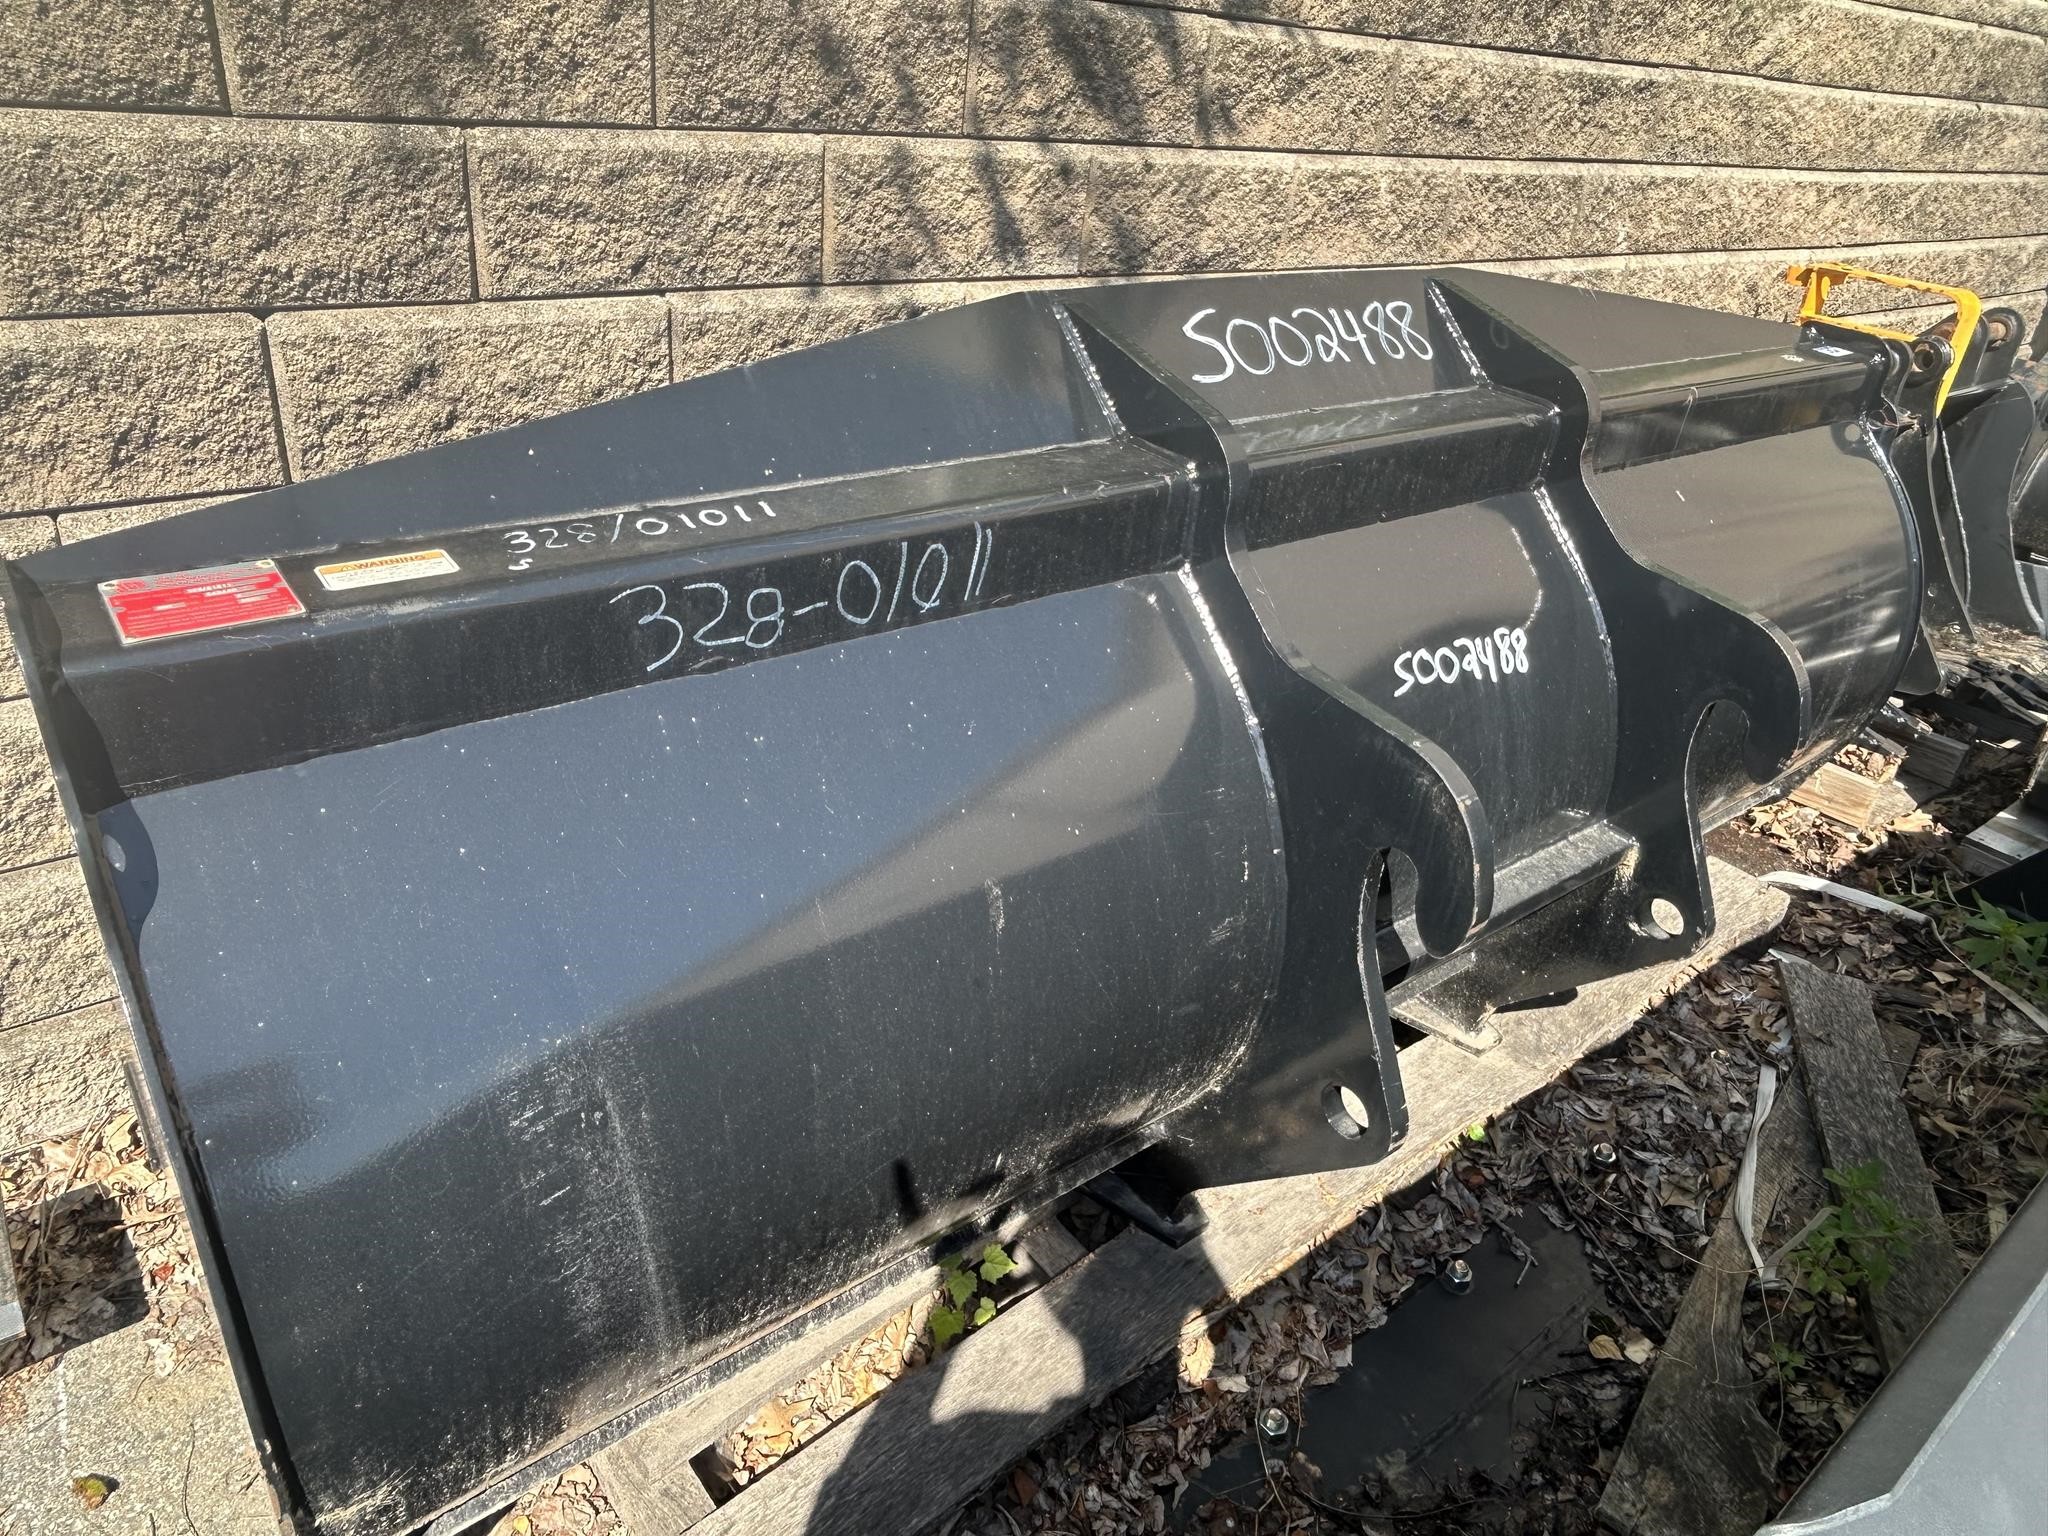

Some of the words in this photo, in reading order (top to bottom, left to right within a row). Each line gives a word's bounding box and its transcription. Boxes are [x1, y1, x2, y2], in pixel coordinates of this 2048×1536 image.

[502, 500, 777, 554] 328/01011
[353, 554, 427, 570] WARNING
[608, 520, 993, 673] 328-01011
